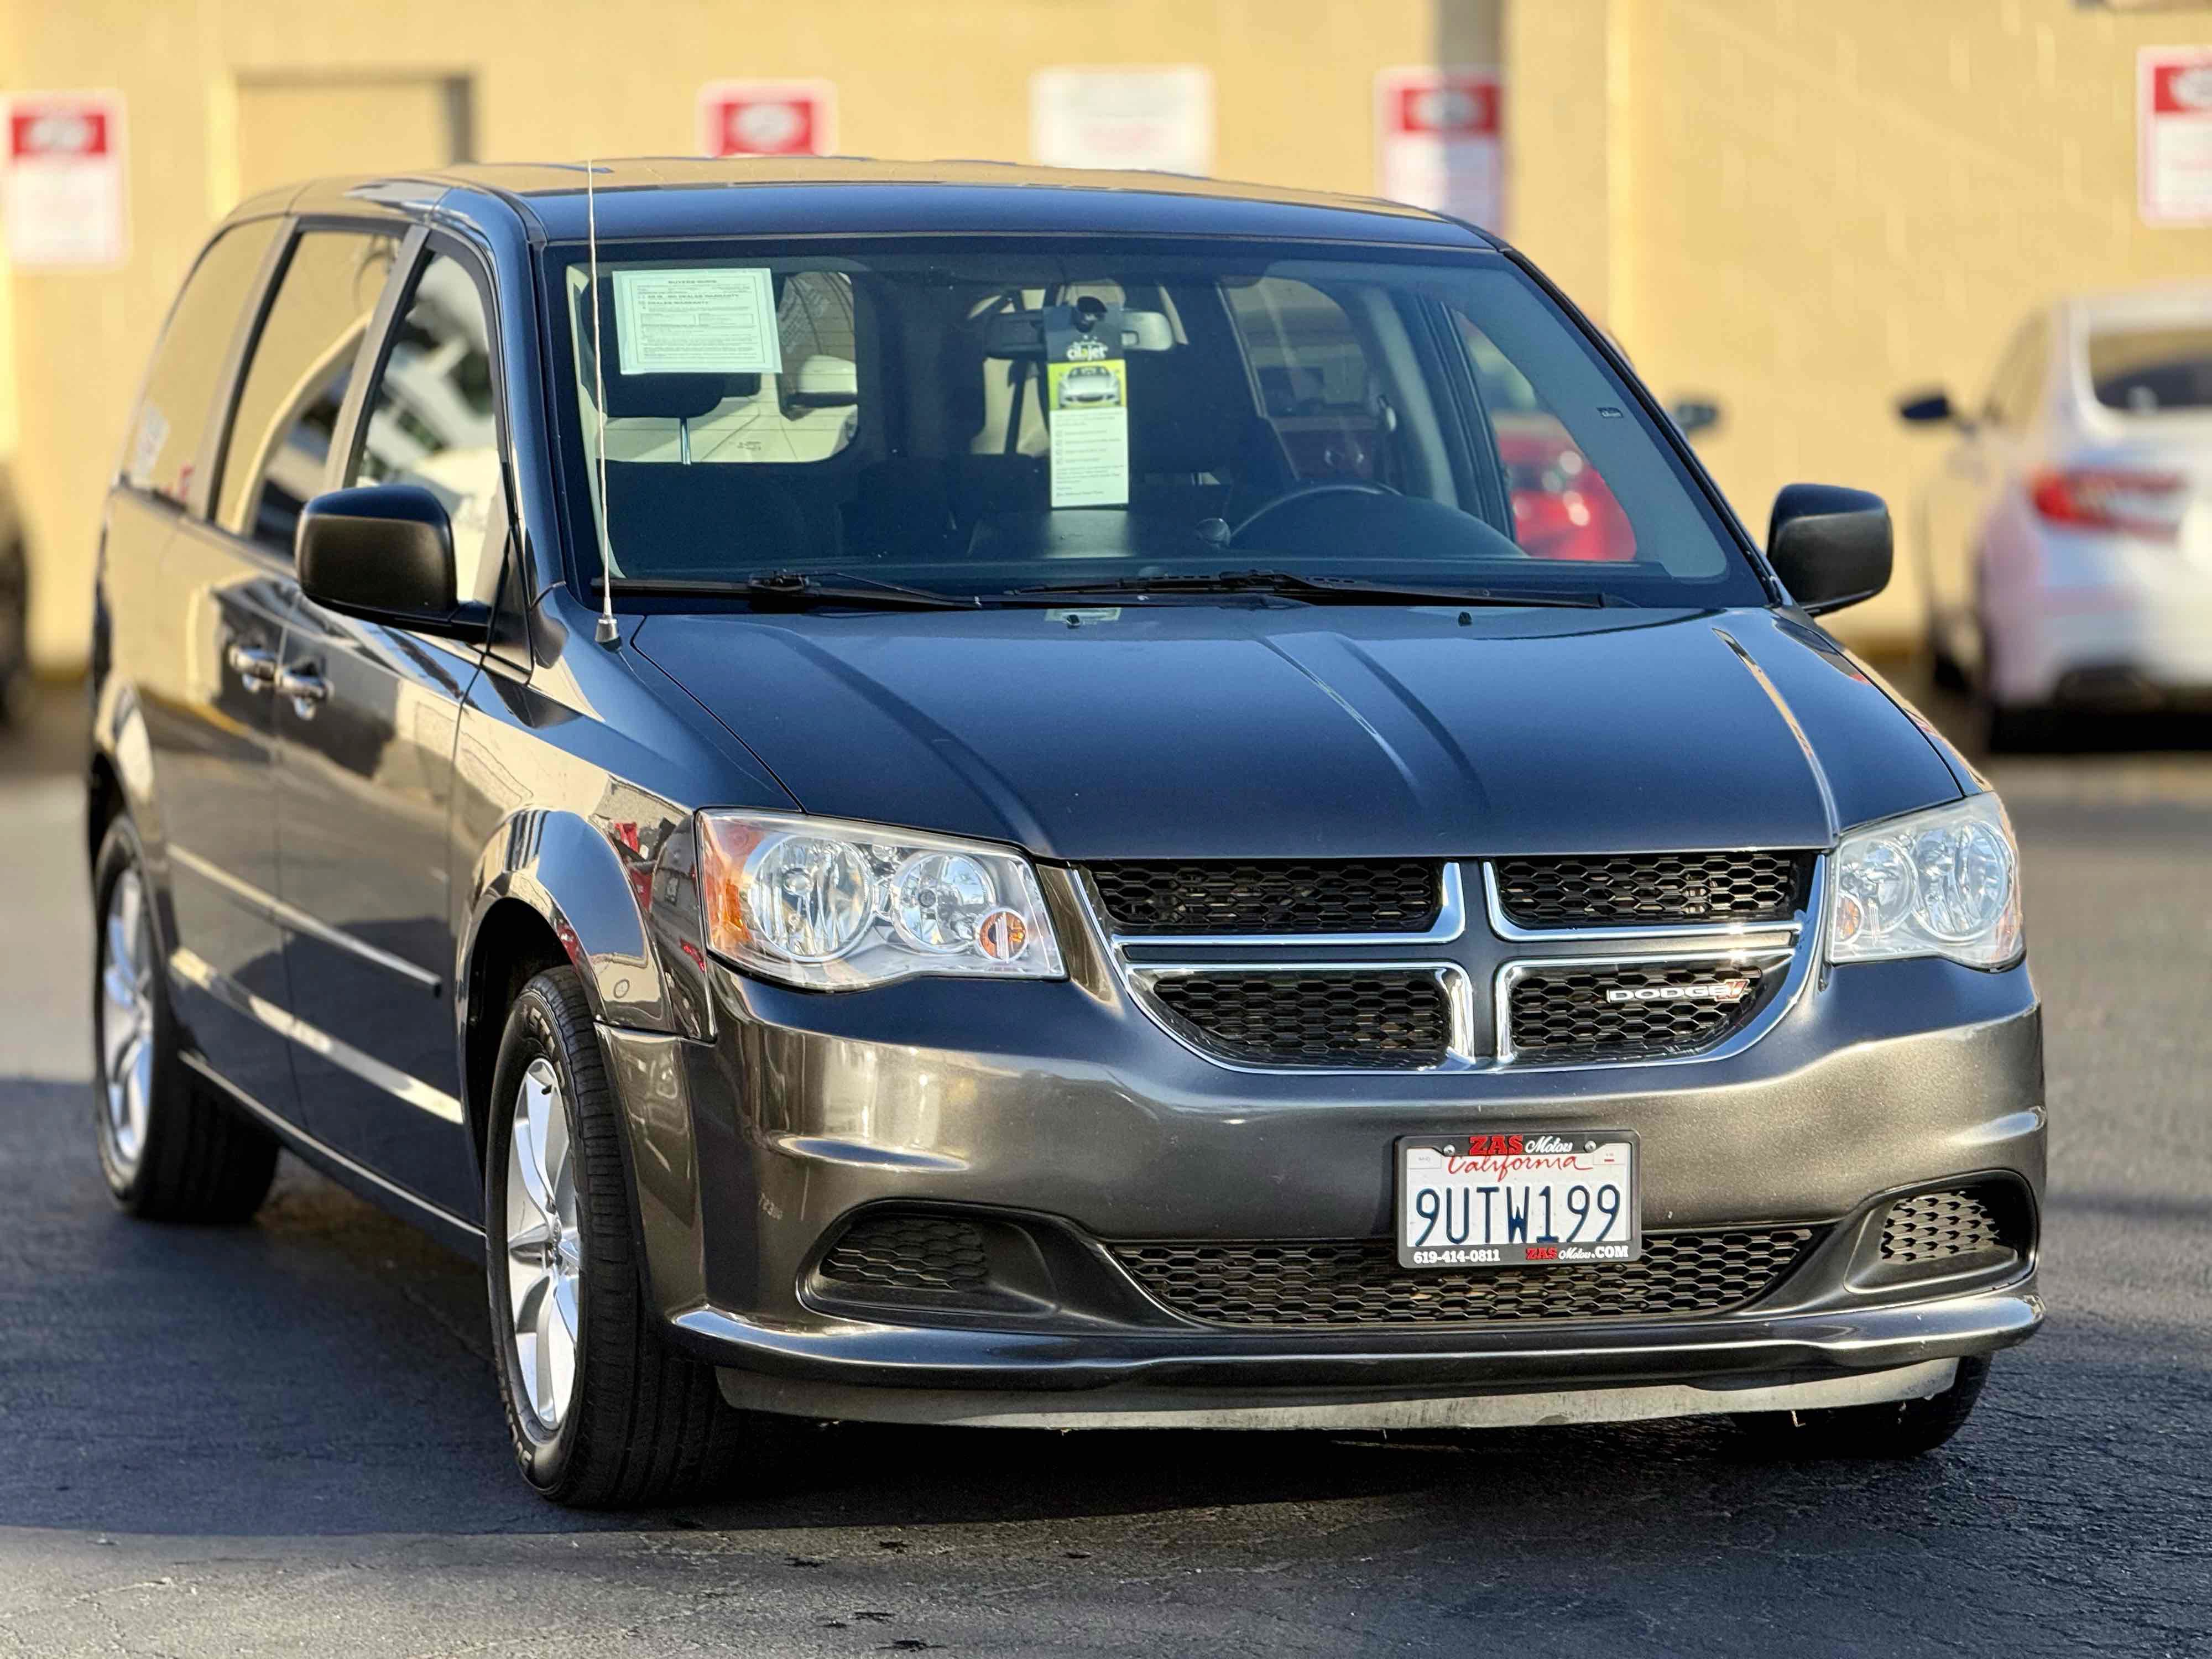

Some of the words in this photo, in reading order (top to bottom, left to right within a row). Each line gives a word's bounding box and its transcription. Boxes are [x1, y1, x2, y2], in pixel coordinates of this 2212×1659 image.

[1609, 985, 1728, 1001] DODGE
[1469, 1134, 1523, 1156] ZAS
[1447, 1154, 1593, 1182] California
[1415, 1185, 1621, 1247] 9UTW199
[1413, 1249, 1500, 1264] 619-414-0811
